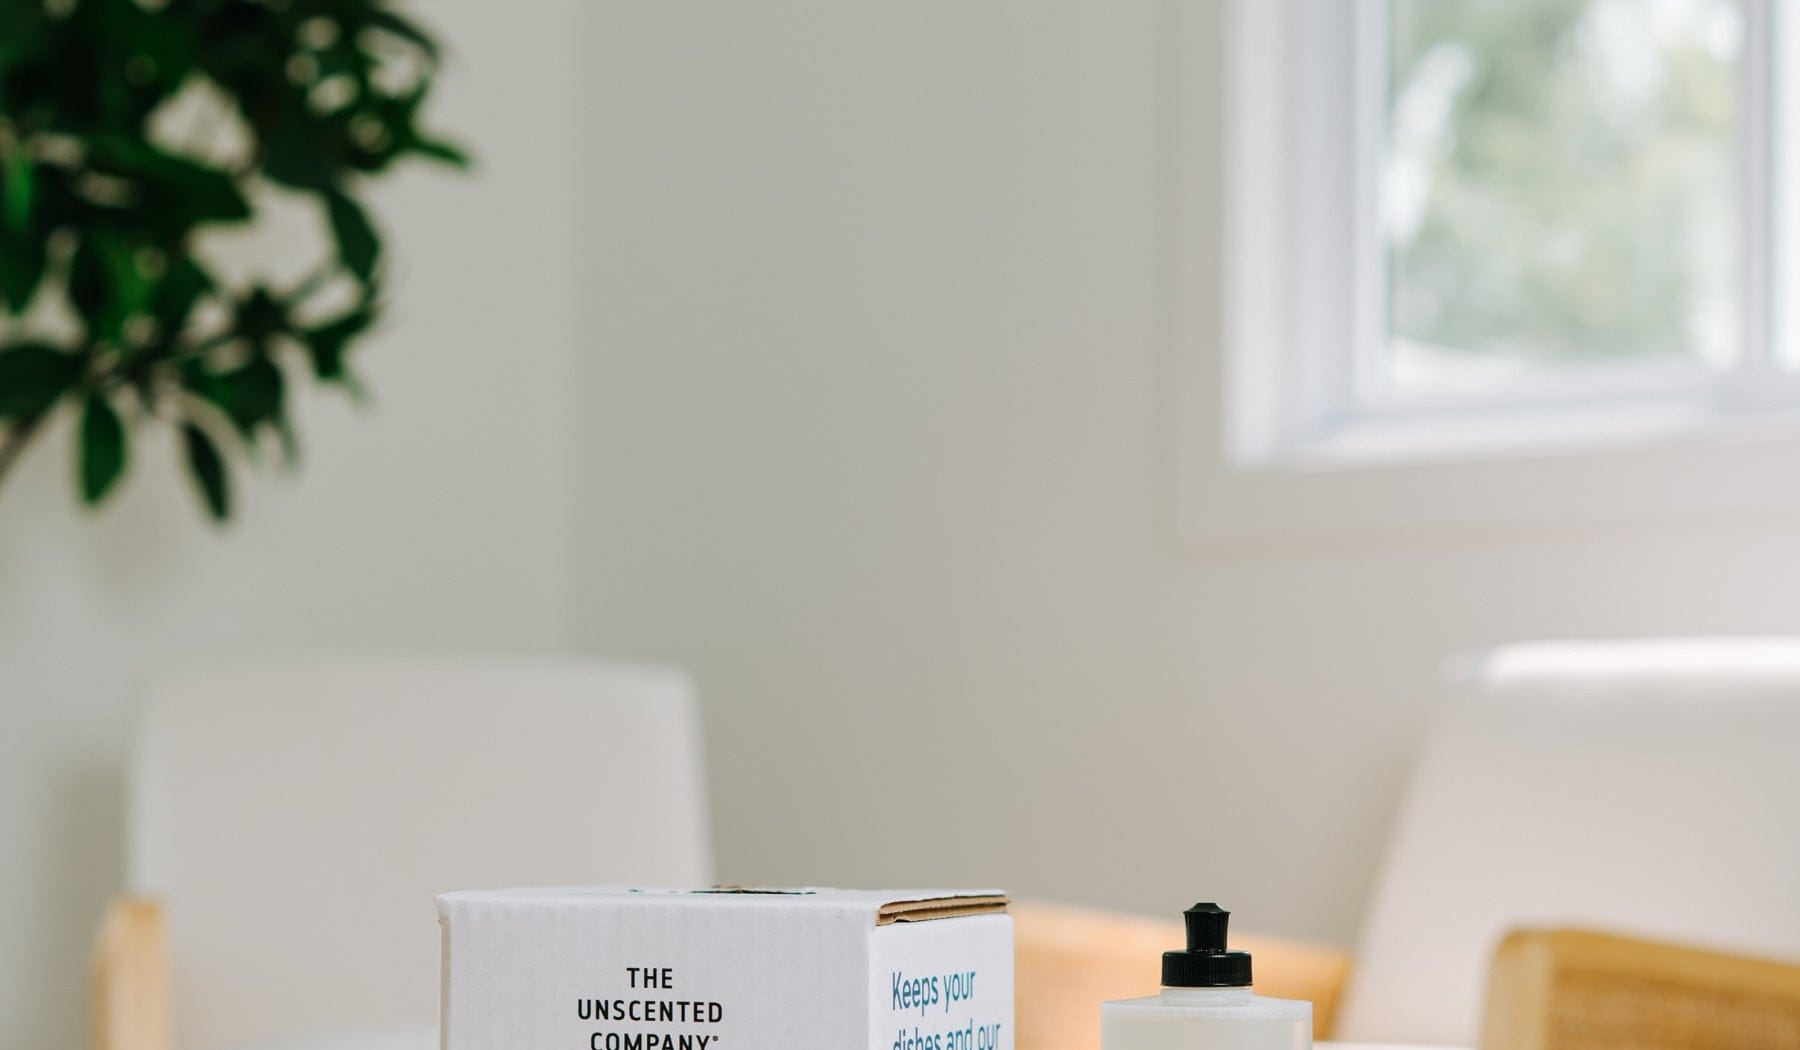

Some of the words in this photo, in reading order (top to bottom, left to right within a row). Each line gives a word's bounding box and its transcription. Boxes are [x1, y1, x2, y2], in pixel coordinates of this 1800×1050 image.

[627, 968, 673, 989] THE
[893, 971, 938, 1016] Keeps
[943, 970, 976, 1013] your
[578, 999, 722, 1023] UNSCENTED
